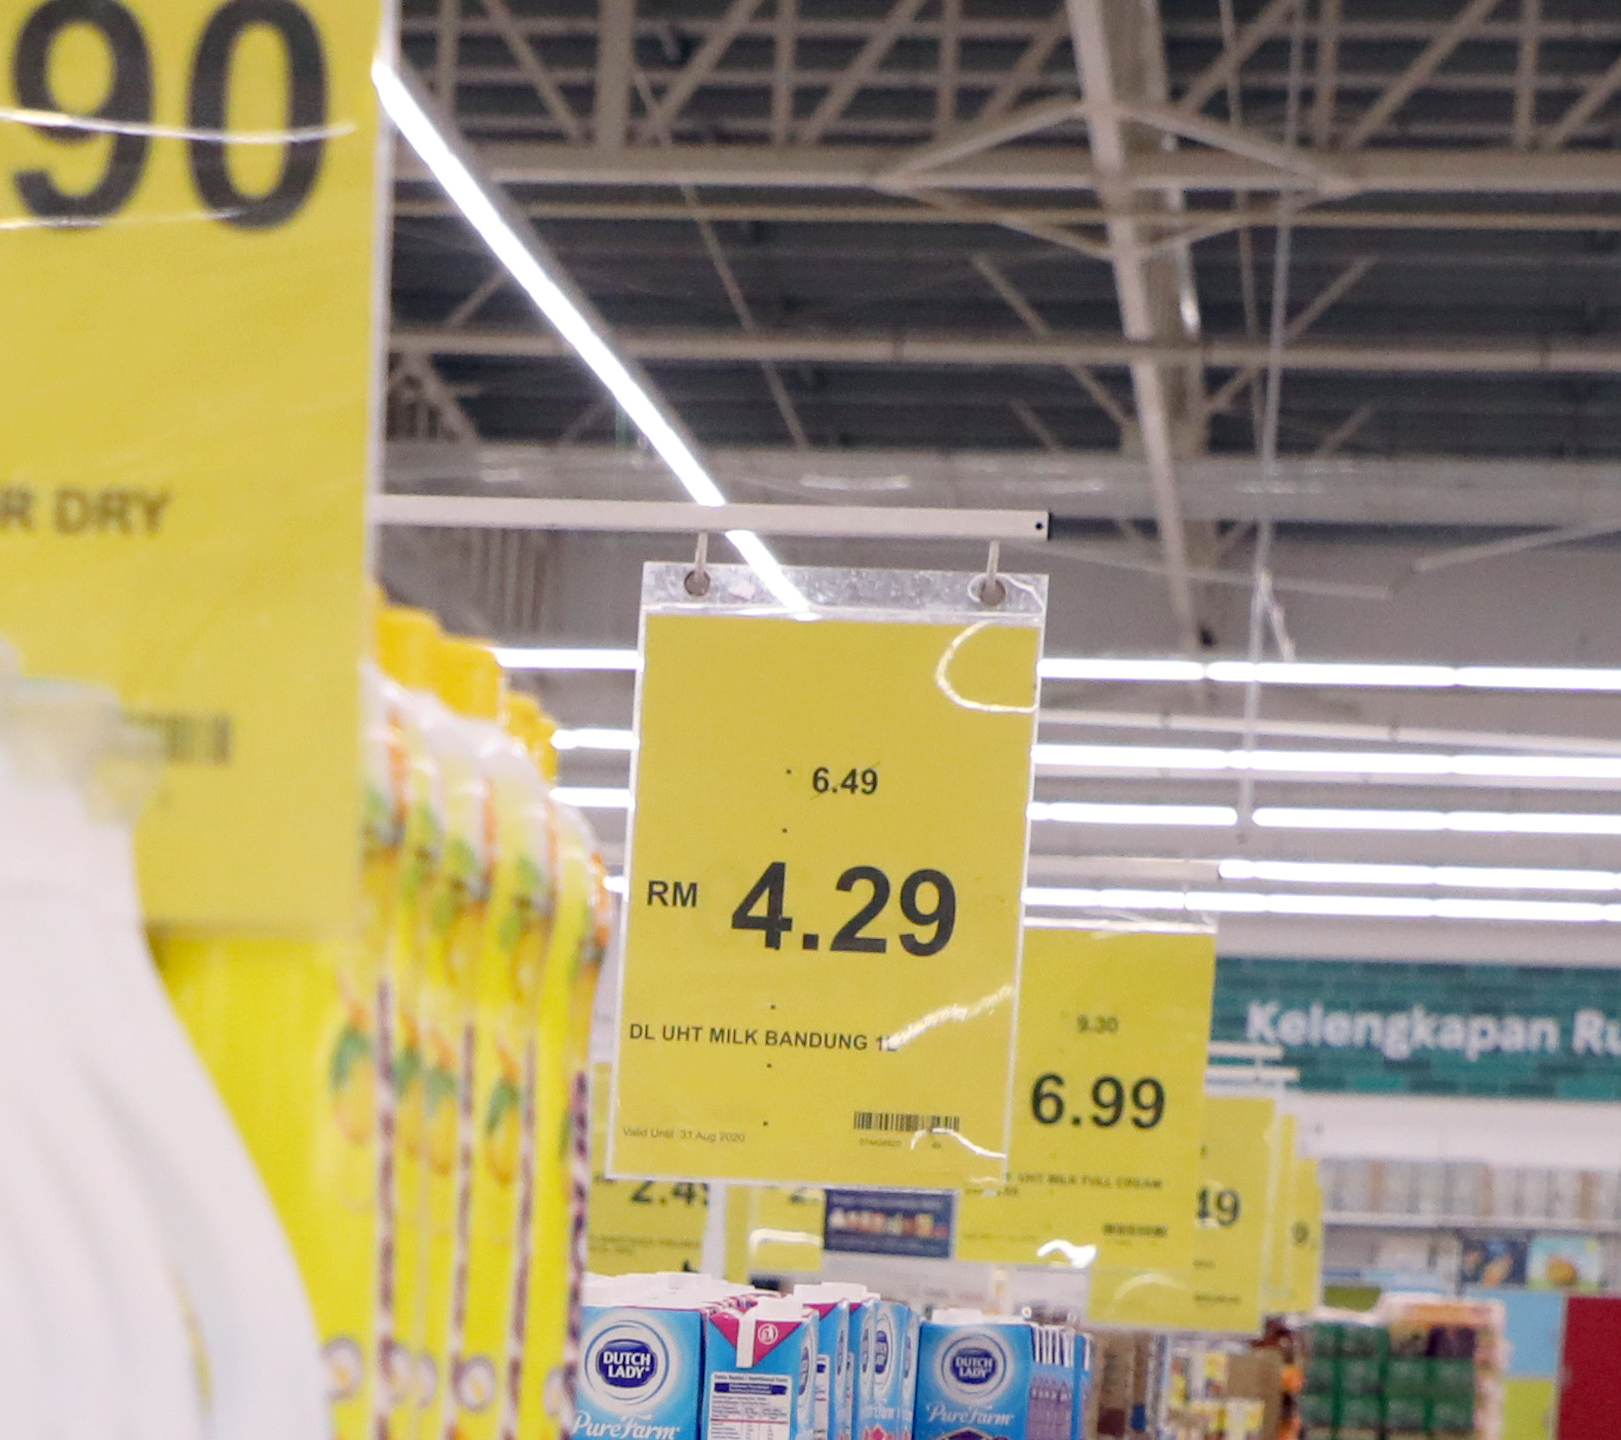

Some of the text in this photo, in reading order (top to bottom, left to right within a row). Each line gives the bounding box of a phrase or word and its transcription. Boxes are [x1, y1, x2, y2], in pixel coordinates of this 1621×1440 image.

[51, 486, 172, 537] DRY
[811, 766, 879, 796] 6.49
[646, 860, 957, 957] RM 4.29
[628, 1023, 656, 1042] DL
[661, 1025, 704, 1044] UHT
[708, 1027, 759, 1047] MILK
[764, 1029, 869, 1051] BANDUNG
[1246, 1002, 1558, 1061] Kelengkapan
[1030, 1073, 1166, 1129] 6.99
[622, 1126, 648, 1140] Valid
[693, 1130, 718, 1144] Aug
[603, 1351, 651, 1366] DUTCH
[608, 1365, 644, 1379] LADY
[954, 1356, 994, 1368] DUTCH
[959, 1366, 989, 1379] LADY
